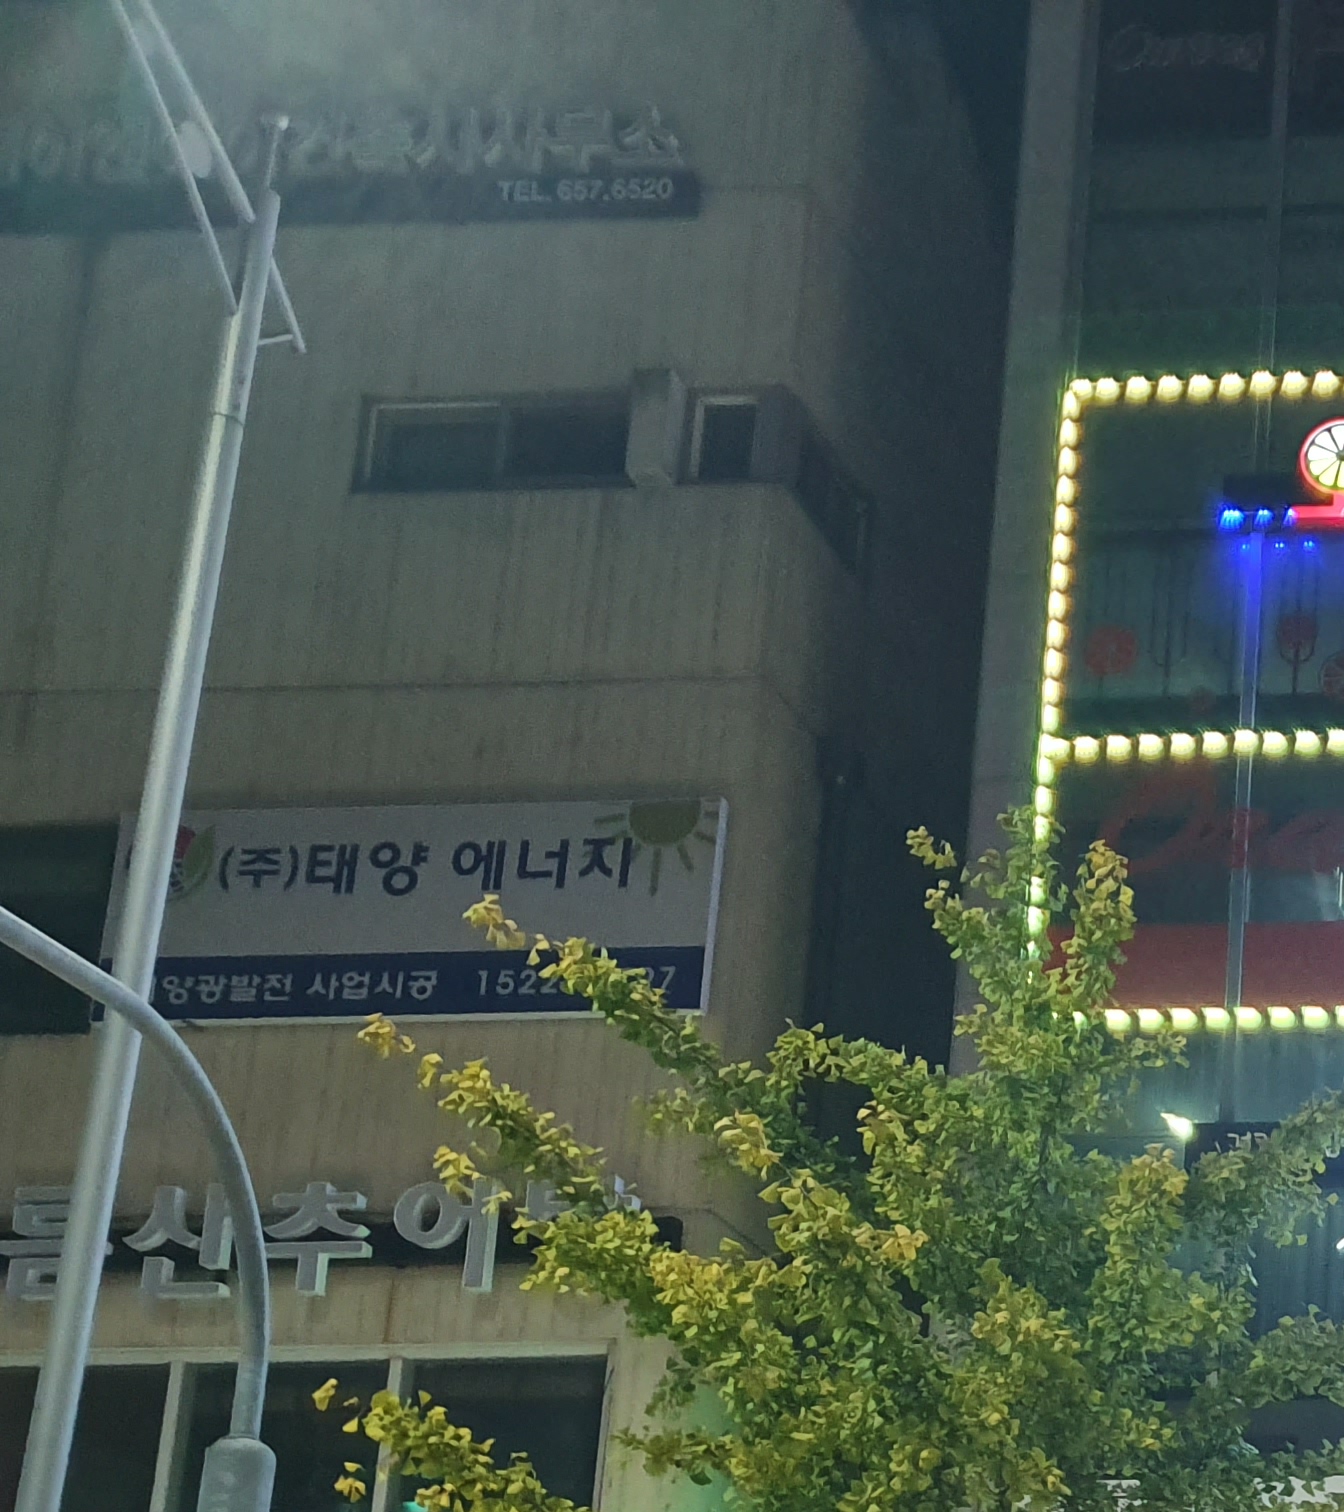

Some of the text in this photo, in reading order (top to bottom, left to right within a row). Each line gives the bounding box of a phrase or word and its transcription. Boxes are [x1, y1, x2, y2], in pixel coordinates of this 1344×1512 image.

[451, 834, 635, 891] 에너지
[151, 971, 293, 1005] 양광발전
[307, 969, 438, 1002] 사업시공
